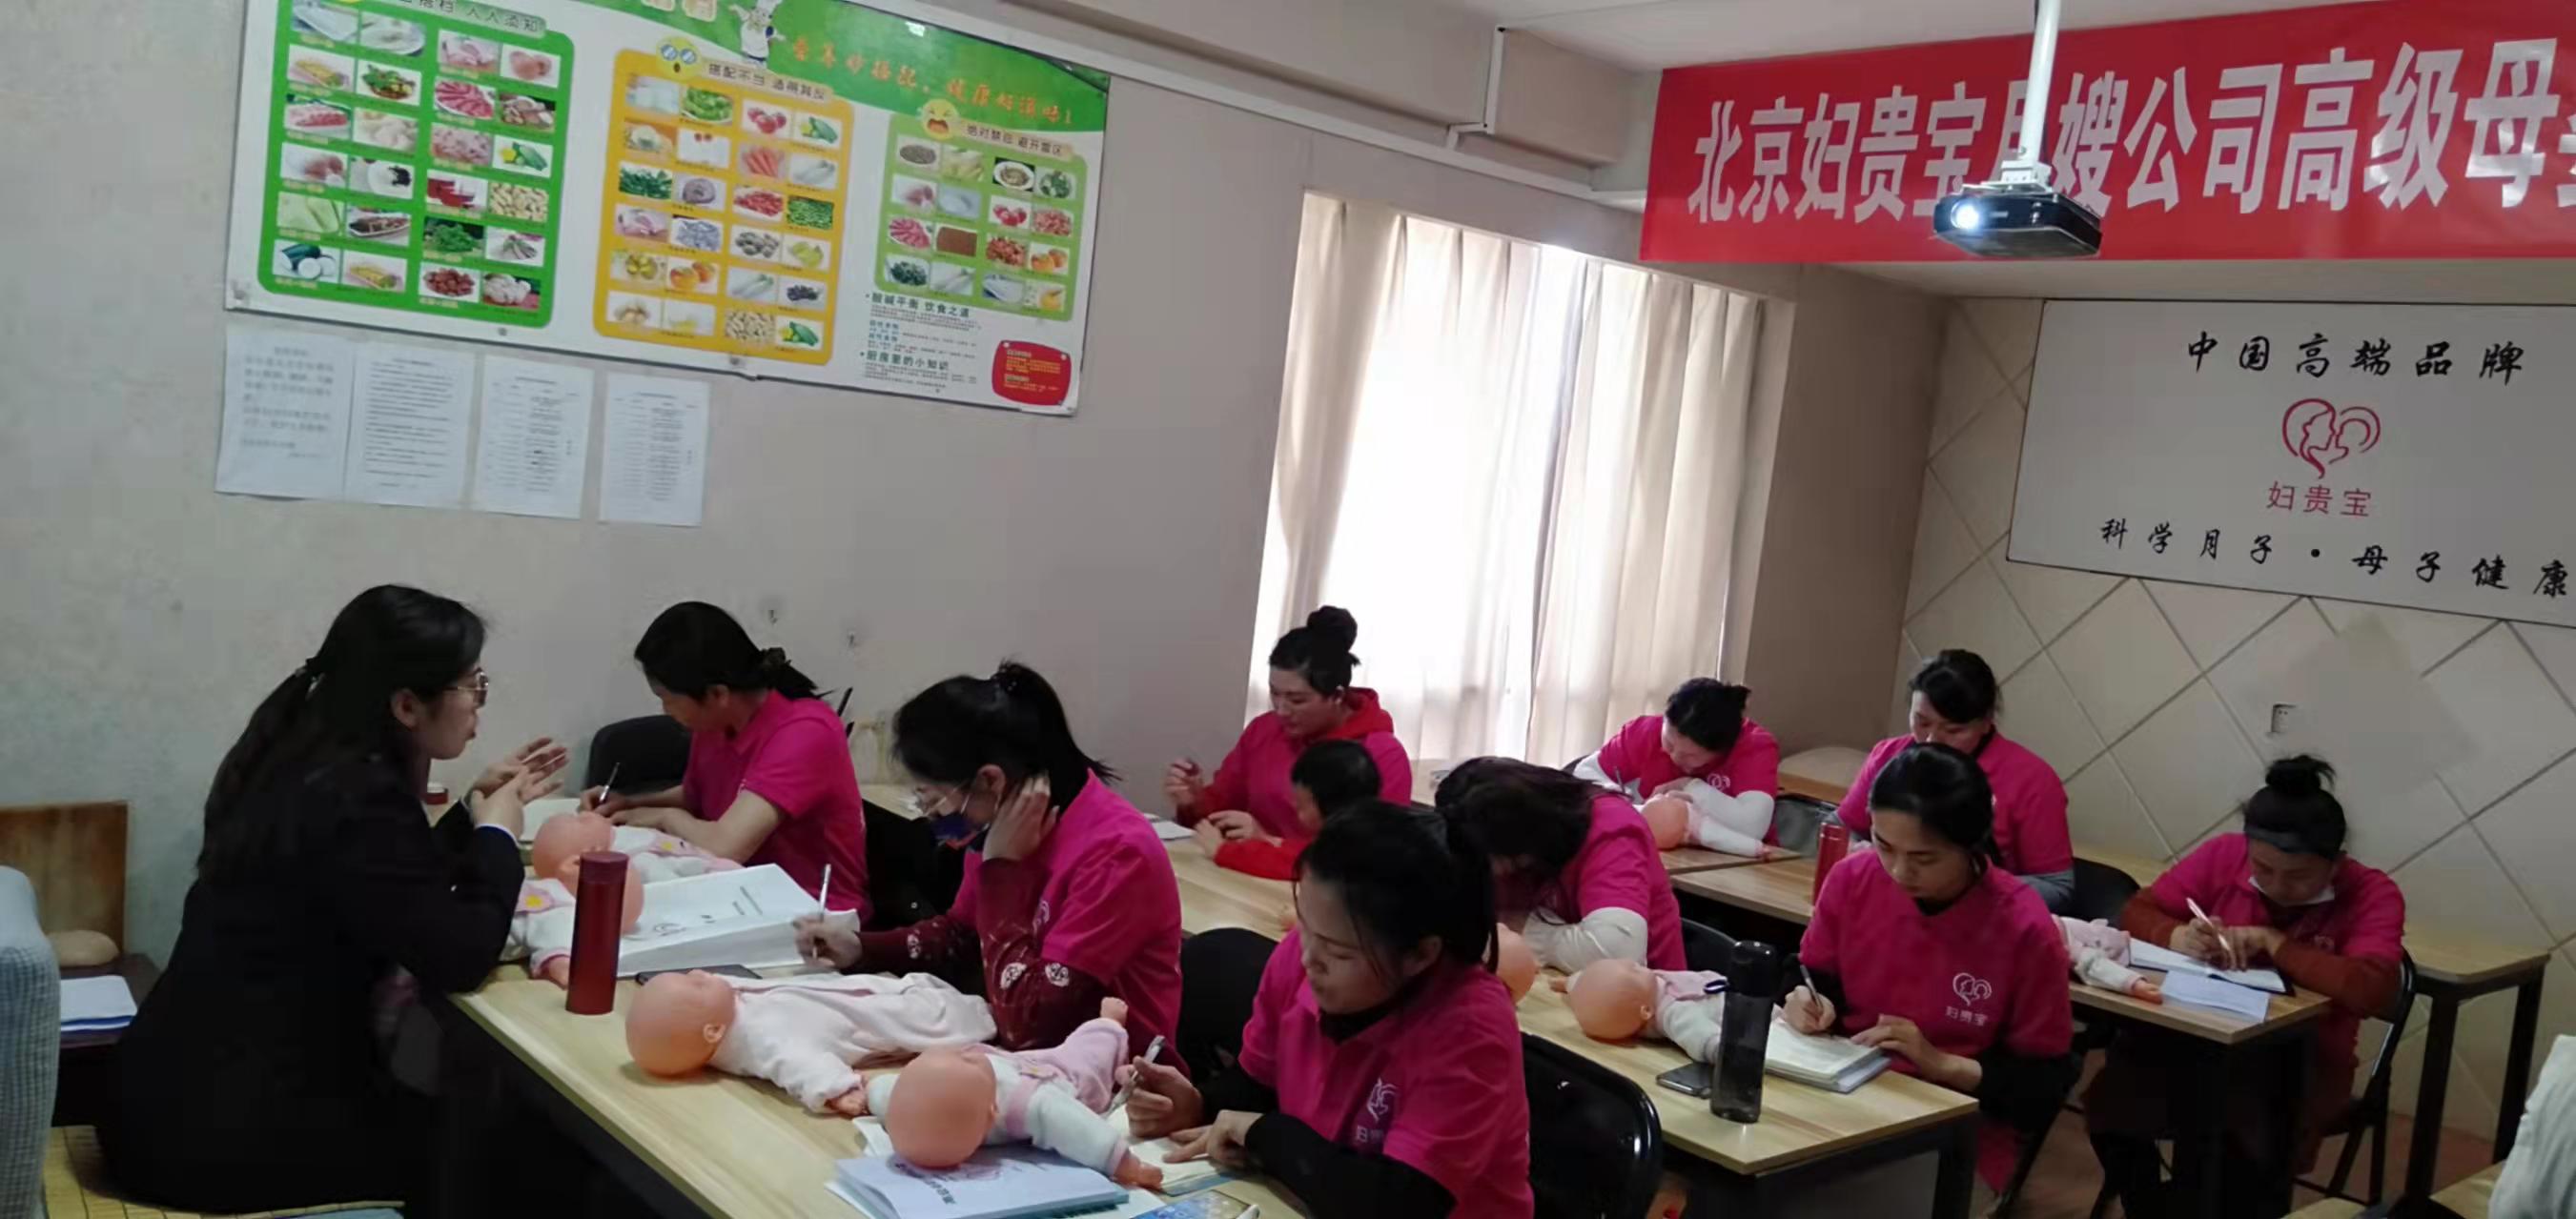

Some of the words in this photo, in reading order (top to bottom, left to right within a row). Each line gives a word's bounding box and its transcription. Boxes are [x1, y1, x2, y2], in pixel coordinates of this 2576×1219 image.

[1687, 37, 2576, 223] 北京妇贵宝月嫂公司高级母
[2187, 331, 2525, 386] 中国高端品牌
[2265, 480, 2372, 518] 妇贵宝
[1945, 1006, 1989, 1026] 妇贵宝
